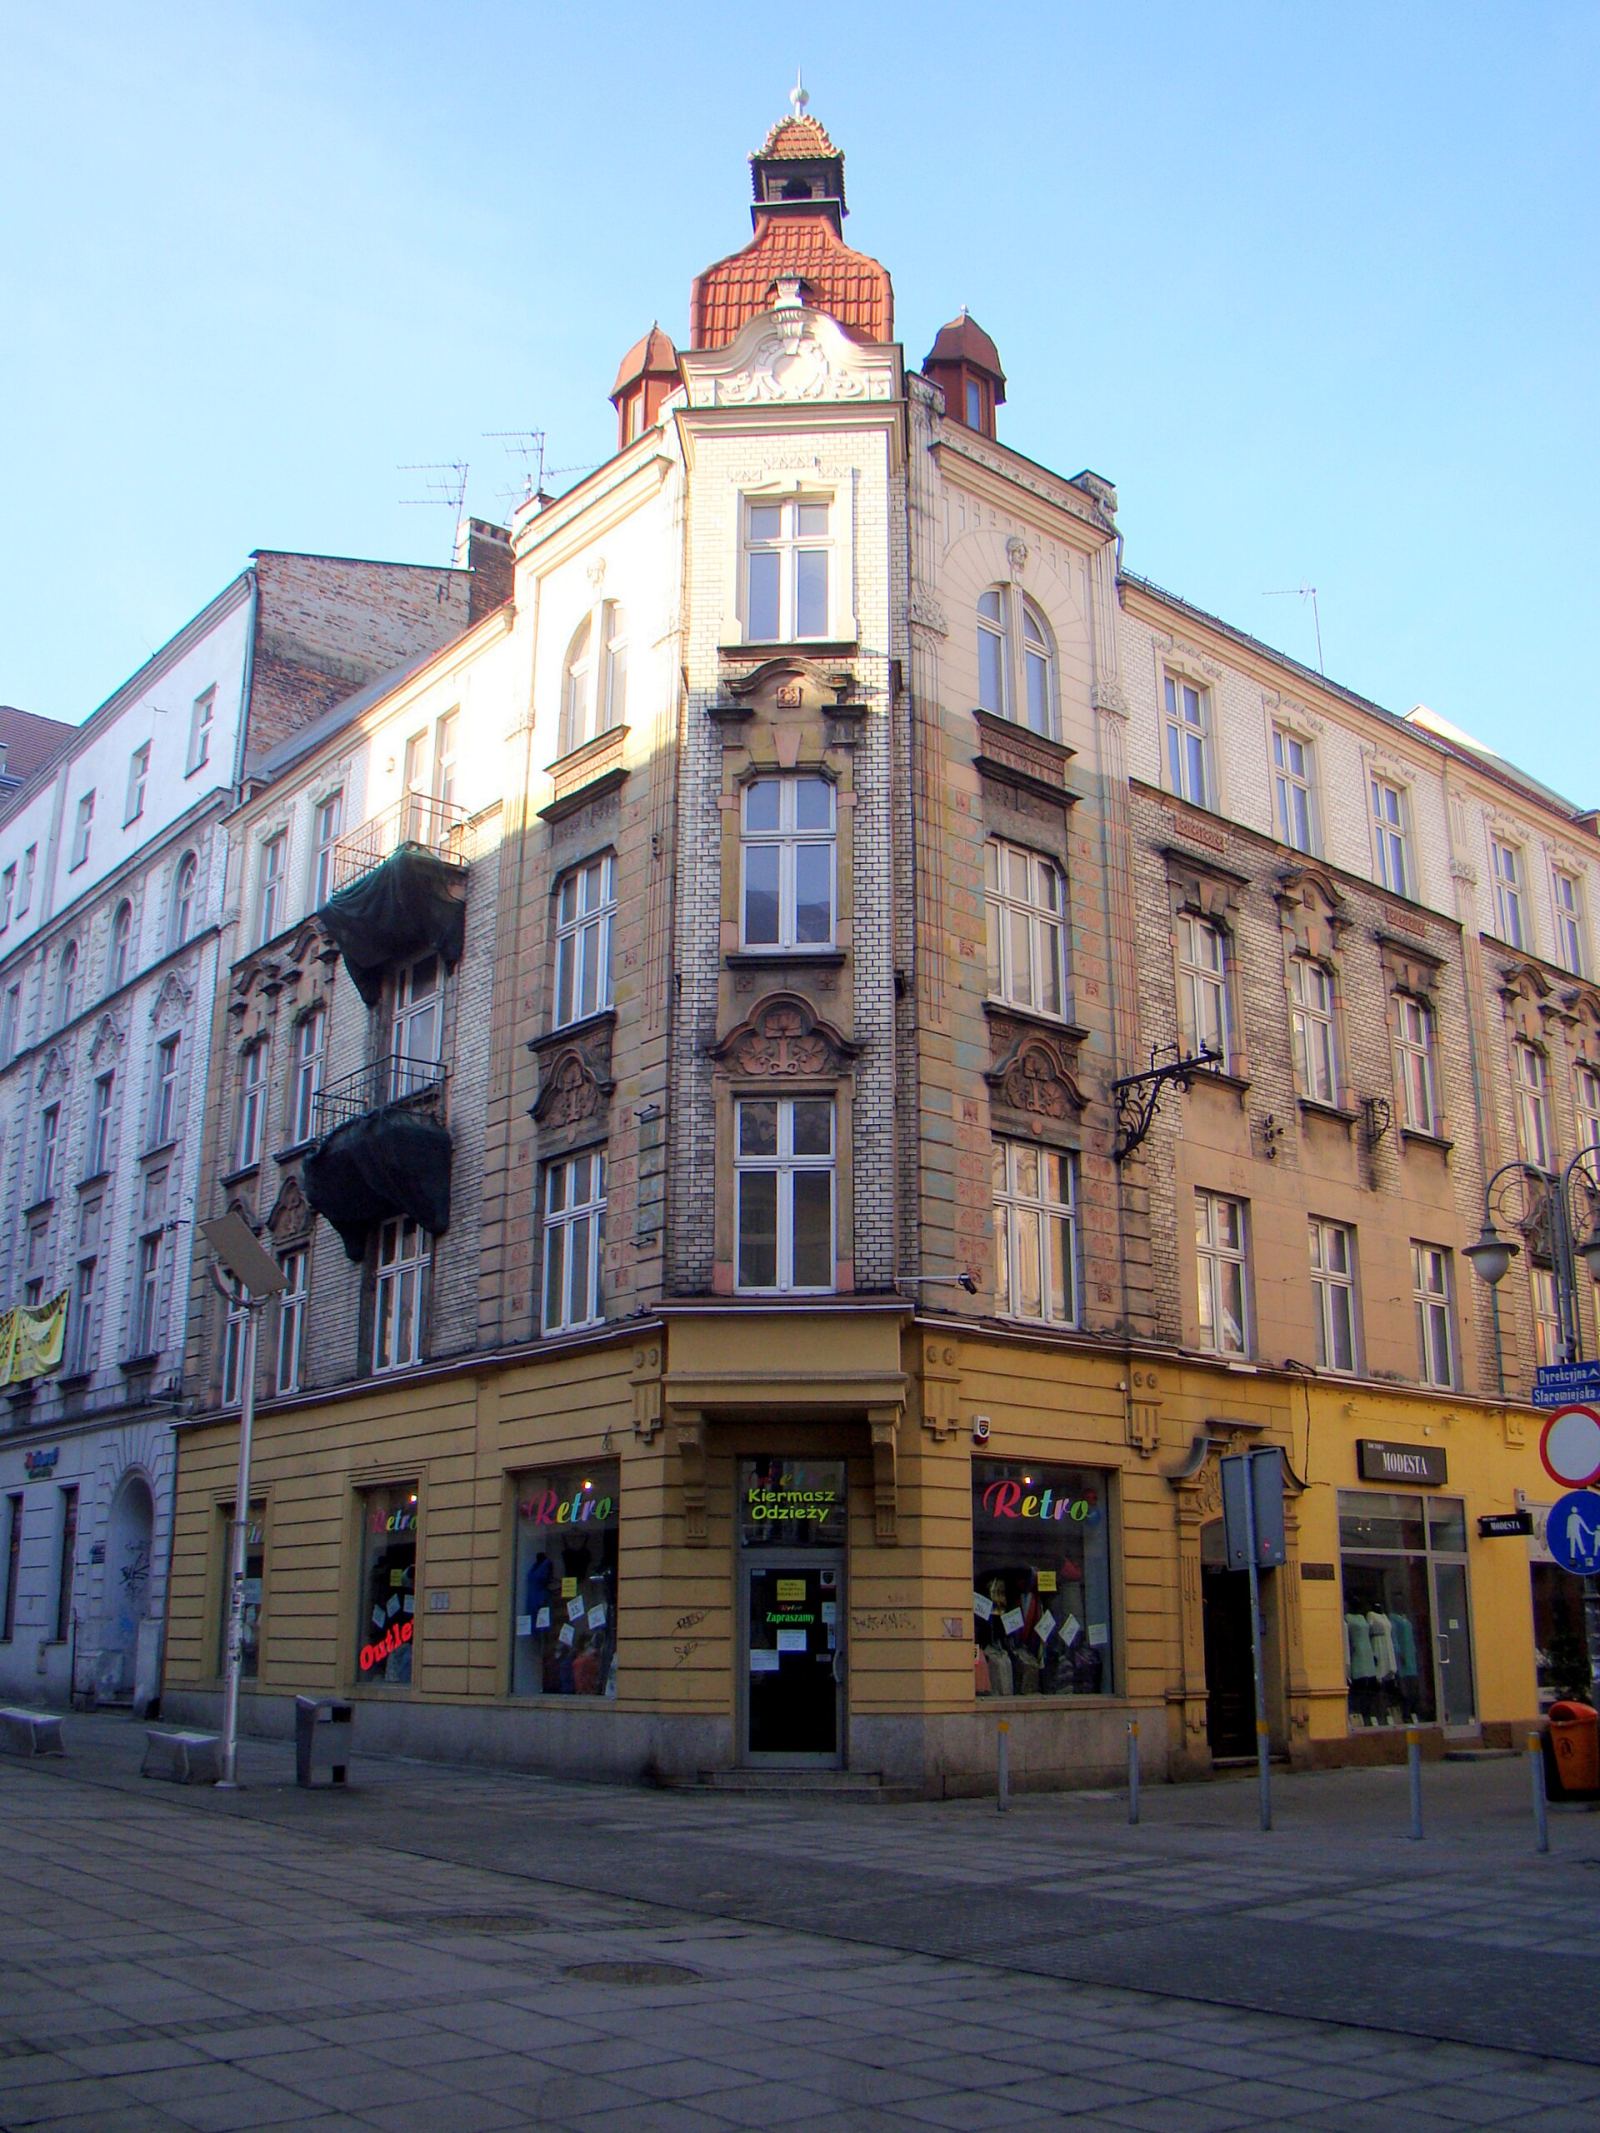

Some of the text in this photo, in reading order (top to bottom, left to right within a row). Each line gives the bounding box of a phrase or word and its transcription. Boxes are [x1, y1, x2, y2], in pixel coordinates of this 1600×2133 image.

[1539, 1367, 1587, 1385] Dyrekcyjna
[1534, 1385, 1596, 1404] Staromiejska
[1382, 1452, 1428, 1475] MODESTA
[748, 1489, 836, 1503] Kiermasz
[983, 1480, 1097, 1521] Retro
[528, 1488, 614, 1526] Retro
[751, 1505, 829, 1523] Odzieży
[1490, 1521, 1521, 1531] MODESTA
[766, 1611, 815, 1625] Zapraszamy
[359, 1618, 414, 1671] Outle
